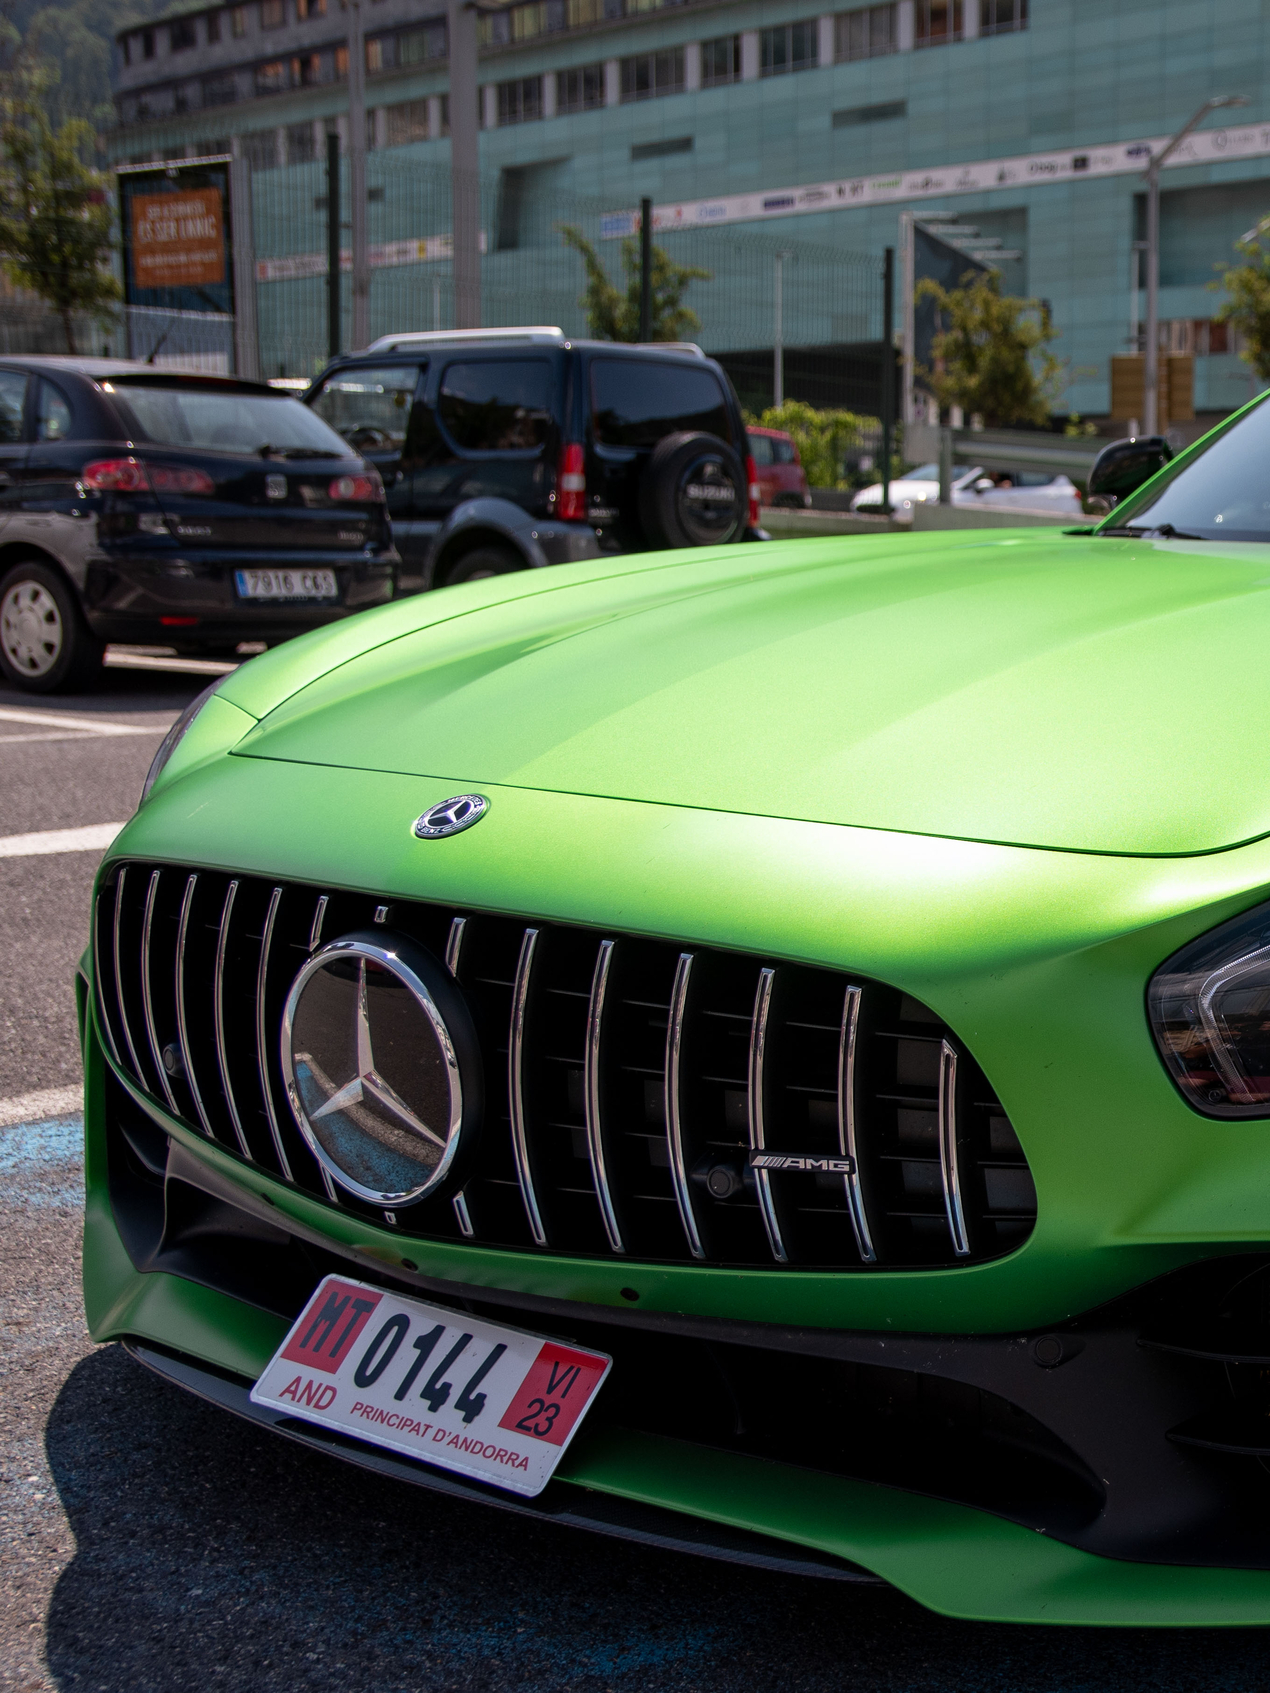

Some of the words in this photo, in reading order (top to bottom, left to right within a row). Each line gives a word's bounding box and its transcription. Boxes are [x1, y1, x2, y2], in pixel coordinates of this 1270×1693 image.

[686, 484, 735, 501] SUZUKI
[781, 1157, 850, 1172] AMG
[353, 1313, 508, 1424] 0144
[546, 1361, 582, 1399] VI
[278, 1375, 337, 1411] AND
[350, 1401, 433, 1438] PRINCIPAT
[433, 1428, 530, 1472] D'ANDORRA
[515, 1398, 561, 1437] 23
